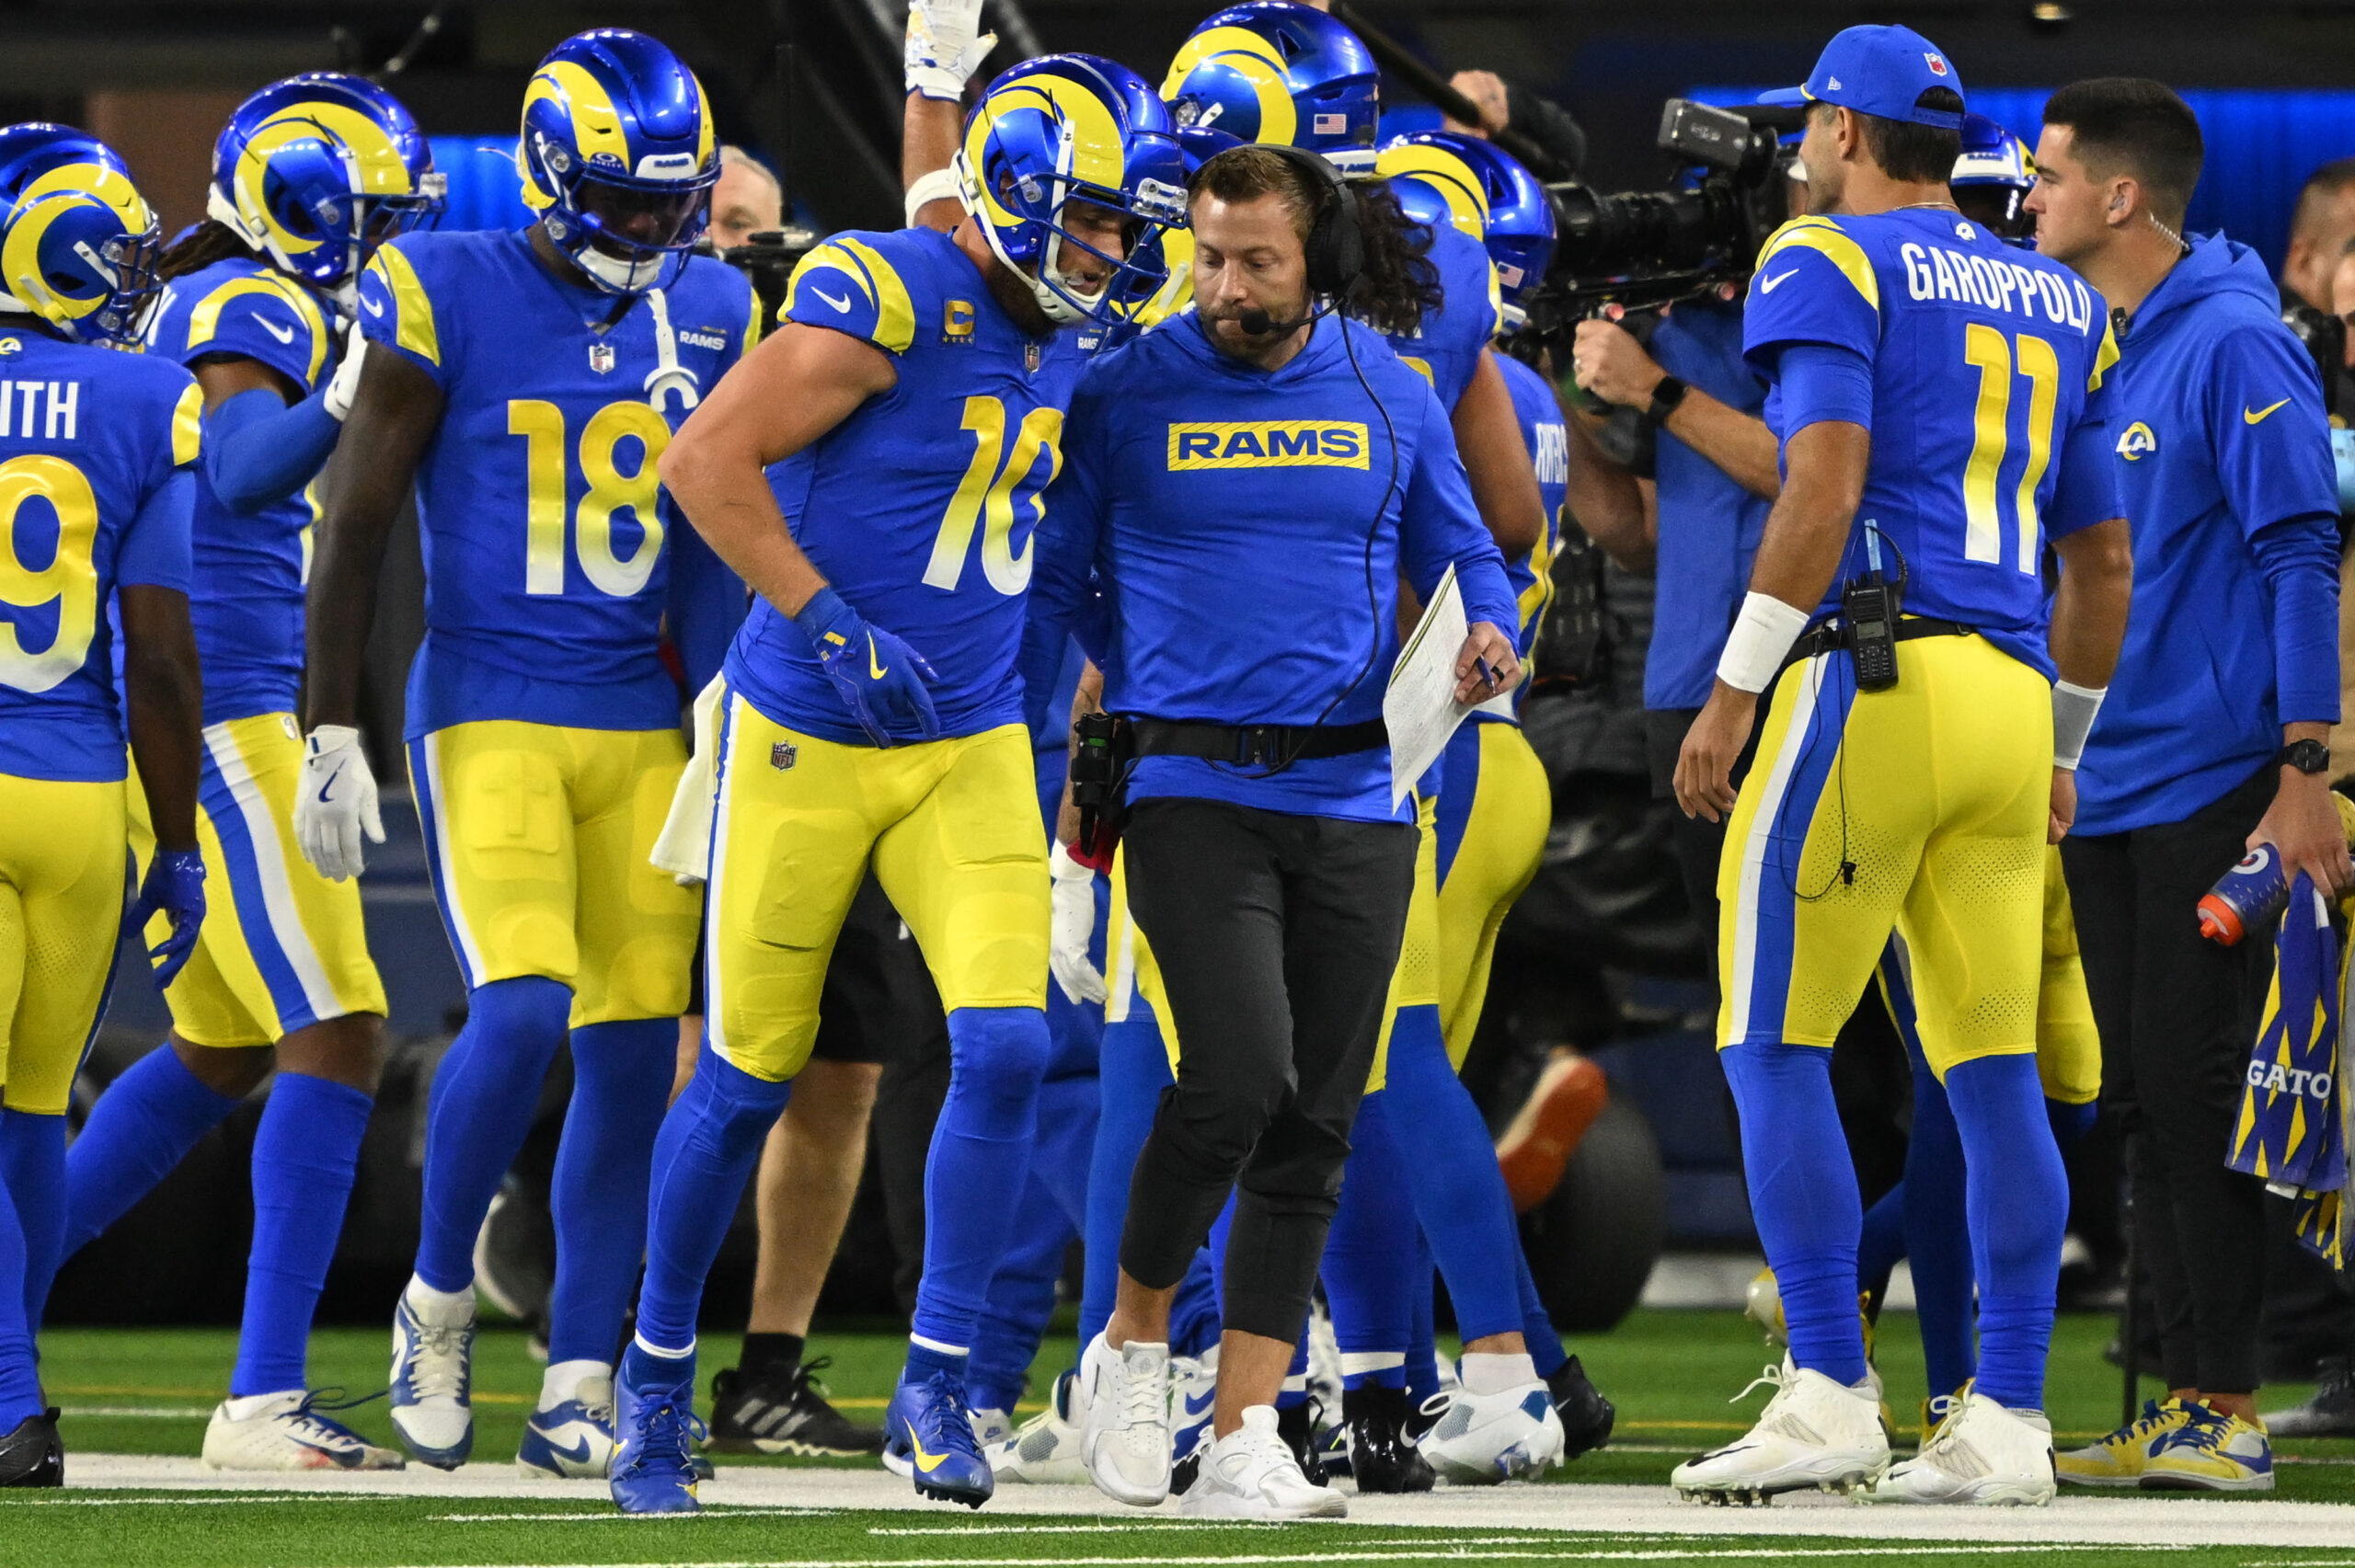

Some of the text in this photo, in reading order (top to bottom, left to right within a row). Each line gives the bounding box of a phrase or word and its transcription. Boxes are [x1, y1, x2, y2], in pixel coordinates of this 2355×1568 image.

[1901, 242, 2092, 338] GAROPPOLO
[680, 331, 726, 350] RAMS
[0, 380, 79, 440] ITH
[1178, 430, 1361, 461] RAMS
[1964, 323, 2061, 576] 11
[508, 398, 675, 598] 18
[922, 395, 1065, 597] 10
[0, 454, 98, 693] 9
[2246, 1059, 2332, 1099] GATO
